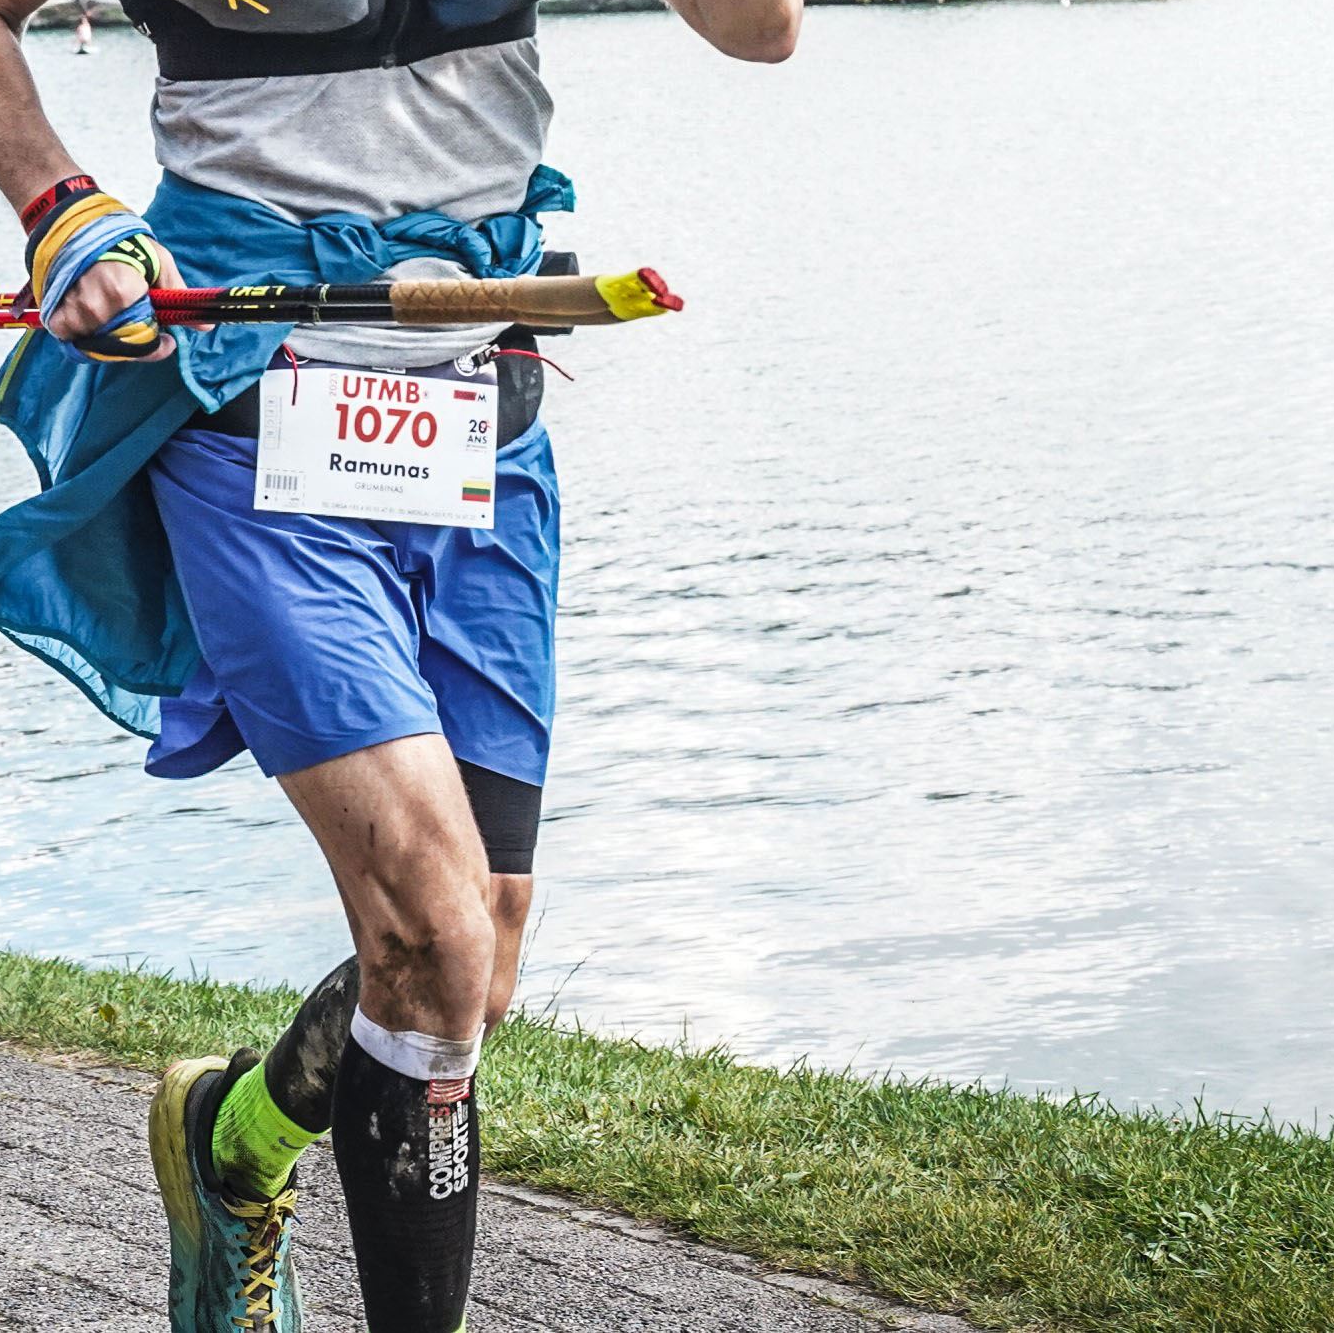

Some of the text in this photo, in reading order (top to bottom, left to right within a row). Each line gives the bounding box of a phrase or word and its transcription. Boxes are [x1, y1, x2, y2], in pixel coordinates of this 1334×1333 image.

[342, 375, 421, 404] UTMB
[334, 403, 438, 448] 1070
[468, 419, 488, 434] 20
[467, 435, 488, 444] ANS
[329, 453, 430, 479] Ramunas
[453, 1111, 468, 1192] SPORT
